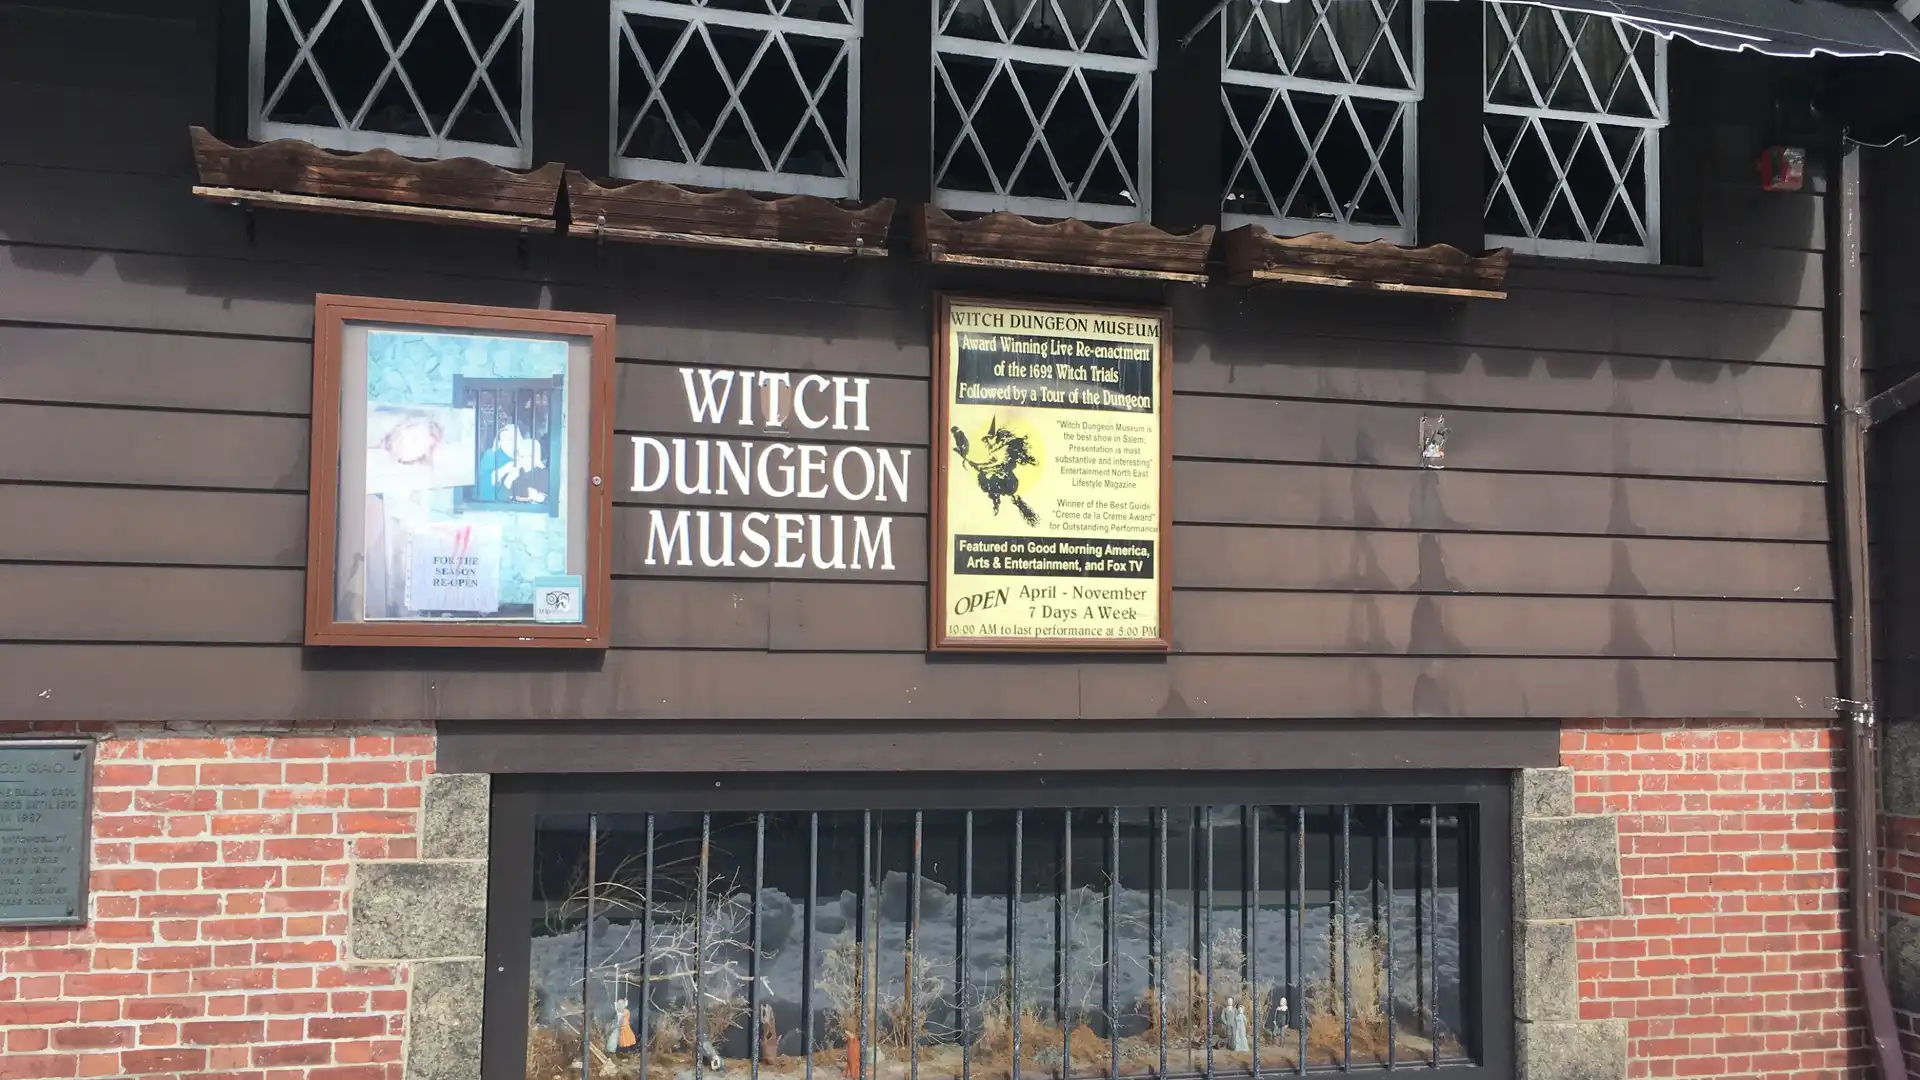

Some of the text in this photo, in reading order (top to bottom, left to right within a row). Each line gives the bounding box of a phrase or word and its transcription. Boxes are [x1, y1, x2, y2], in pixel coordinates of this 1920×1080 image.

[951, 311, 1160, 338] WITCH DUNGEON MUSEUM
[962, 335, 1150, 361] Award Winning Live Re-enactment
[994, 360, 1119, 384] of the 1692 Witch Trials
[679, 367, 870, 431] WITCH
[959, 382, 1151, 410] Followed by a Tour of the Dungeon
[1082, 421, 1114, 433] Dungeon
[1115, 423, 1144, 432] Museum
[1064, 432, 1074, 440] the
[1077, 432, 1092, 441] best
[1094, 434, 1112, 442] show
[1114, 435, 1120, 443] in
[1069, 444, 1141, 455] Presentation is most
[1055, 455, 1097, 465] substantive
[1098, 456, 1112, 465] and
[630, 437, 911, 502] DUNGEON
[1060, 466, 1149, 478] Entertainment North East
[1071, 478, 1137, 490] Lifestyle Magazine
[1057, 498, 1151, 510] Winner of the Best Guide
[1083, 511, 1092, 519] de
[1094, 511, 1101, 520] la
[1103, 511, 1127, 520] Creme
[1049, 521, 1060, 530] for
[1062, 521, 1109, 533] Outstanding
[644, 510, 896, 570] MUSEUM
[959, 540, 1150, 559] Featured on Good Morning America,
[433, 556, 479, 565] FOR THE
[967, 556, 1143, 572] Arts & Entertainment, and Fox TV
[436, 567, 477, 576] SEASON
[433, 578, 478, 587] RE-OPEN
[1019, 585, 1056, 602] April
[1072, 586, 1147, 600] November
[954, 586, 1010, 616] OPEN
[1029, 606, 1137, 622] 7 Days A Week
[979, 624, 996, 634] AM
[1001, 626, 1012, 635] to
[1014, 625, 1031, 635] last
[1035, 625, 1103, 638] performance
[1142, 625, 1157, 636] PM
